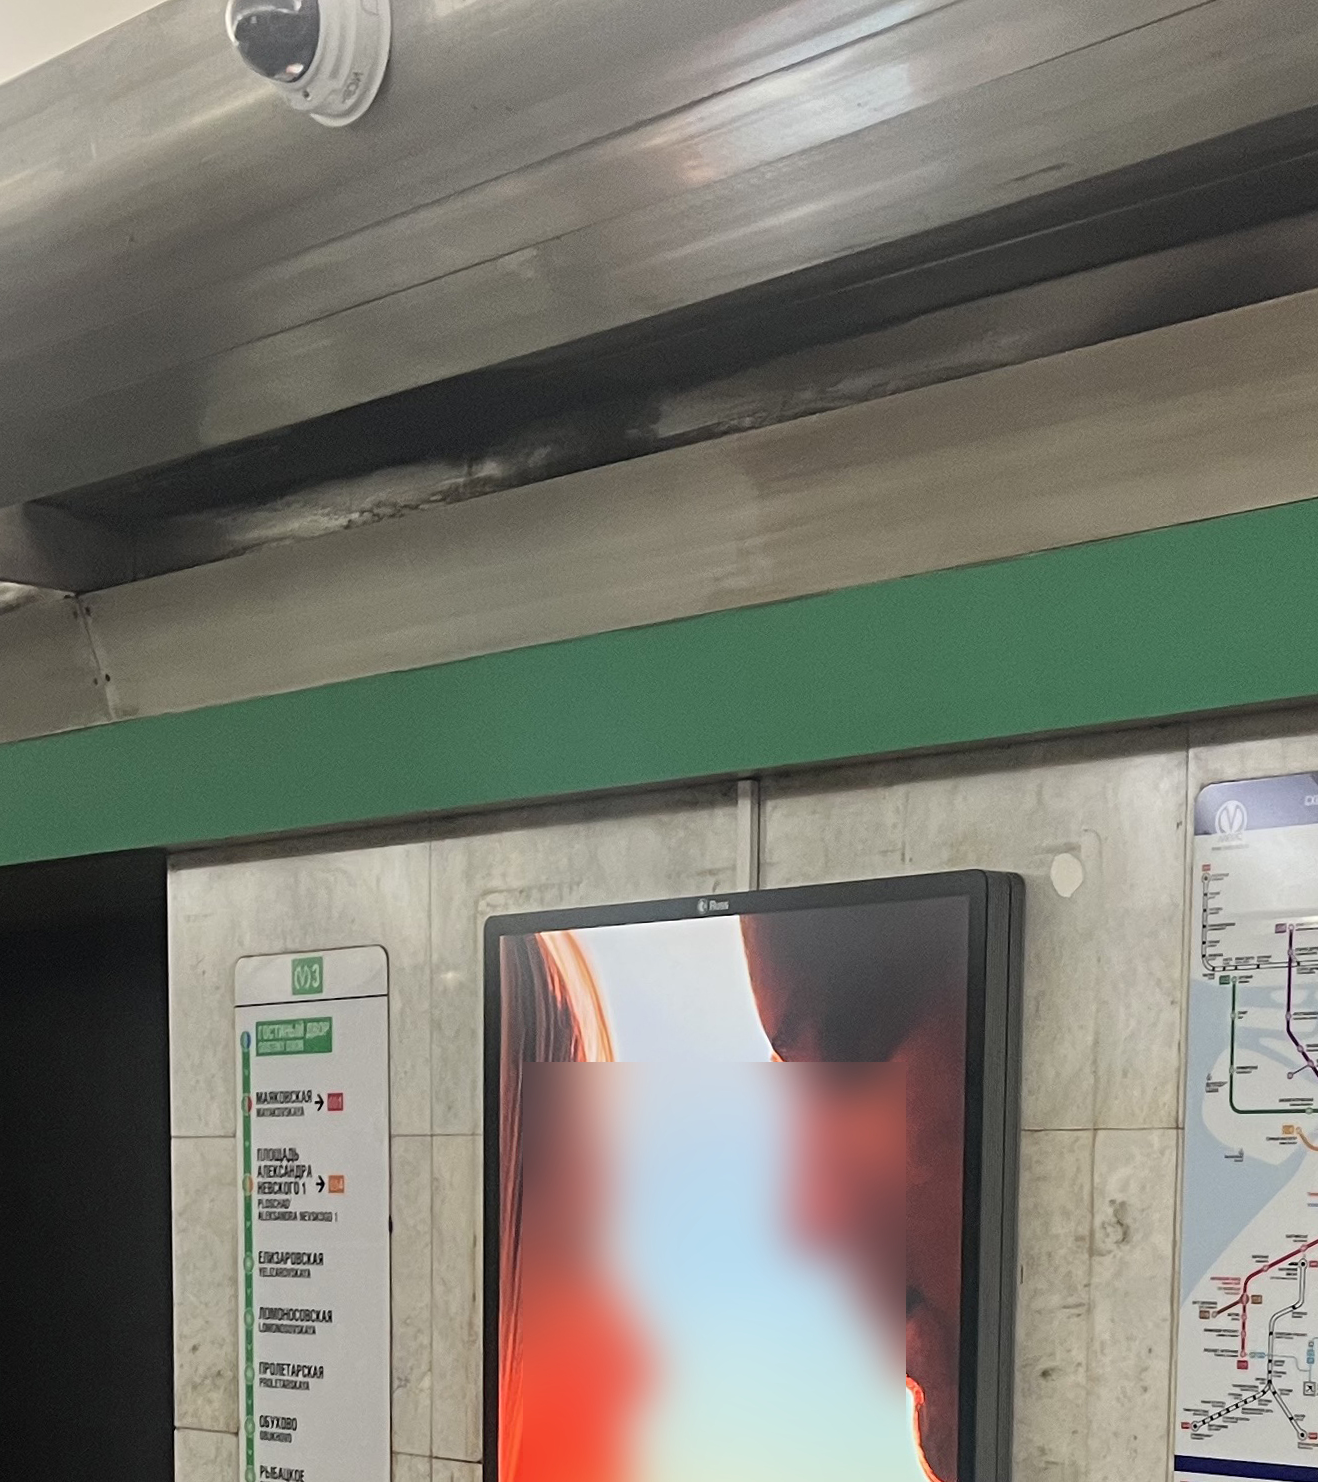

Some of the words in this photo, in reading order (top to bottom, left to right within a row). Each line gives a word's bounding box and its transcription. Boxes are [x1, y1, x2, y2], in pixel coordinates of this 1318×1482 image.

[257, 1164, 313, 1180] АЛЕКСАНДРА
[257, 1181, 300, 1195] НЕВСКОГО
[258, 1250, 324, 1266] ЕЛИЗАРОВСКАЯ
[258, 1306, 333, 1323] ЛОМОНОСОВСКАЯ
[259, 1361, 325, 1379] ПРОЛЕТАРСКАЯ
[259, 1414, 298, 1431] ОБУХОВО
[259, 1464, 305, 1482] РЫБАЦКОЕ
